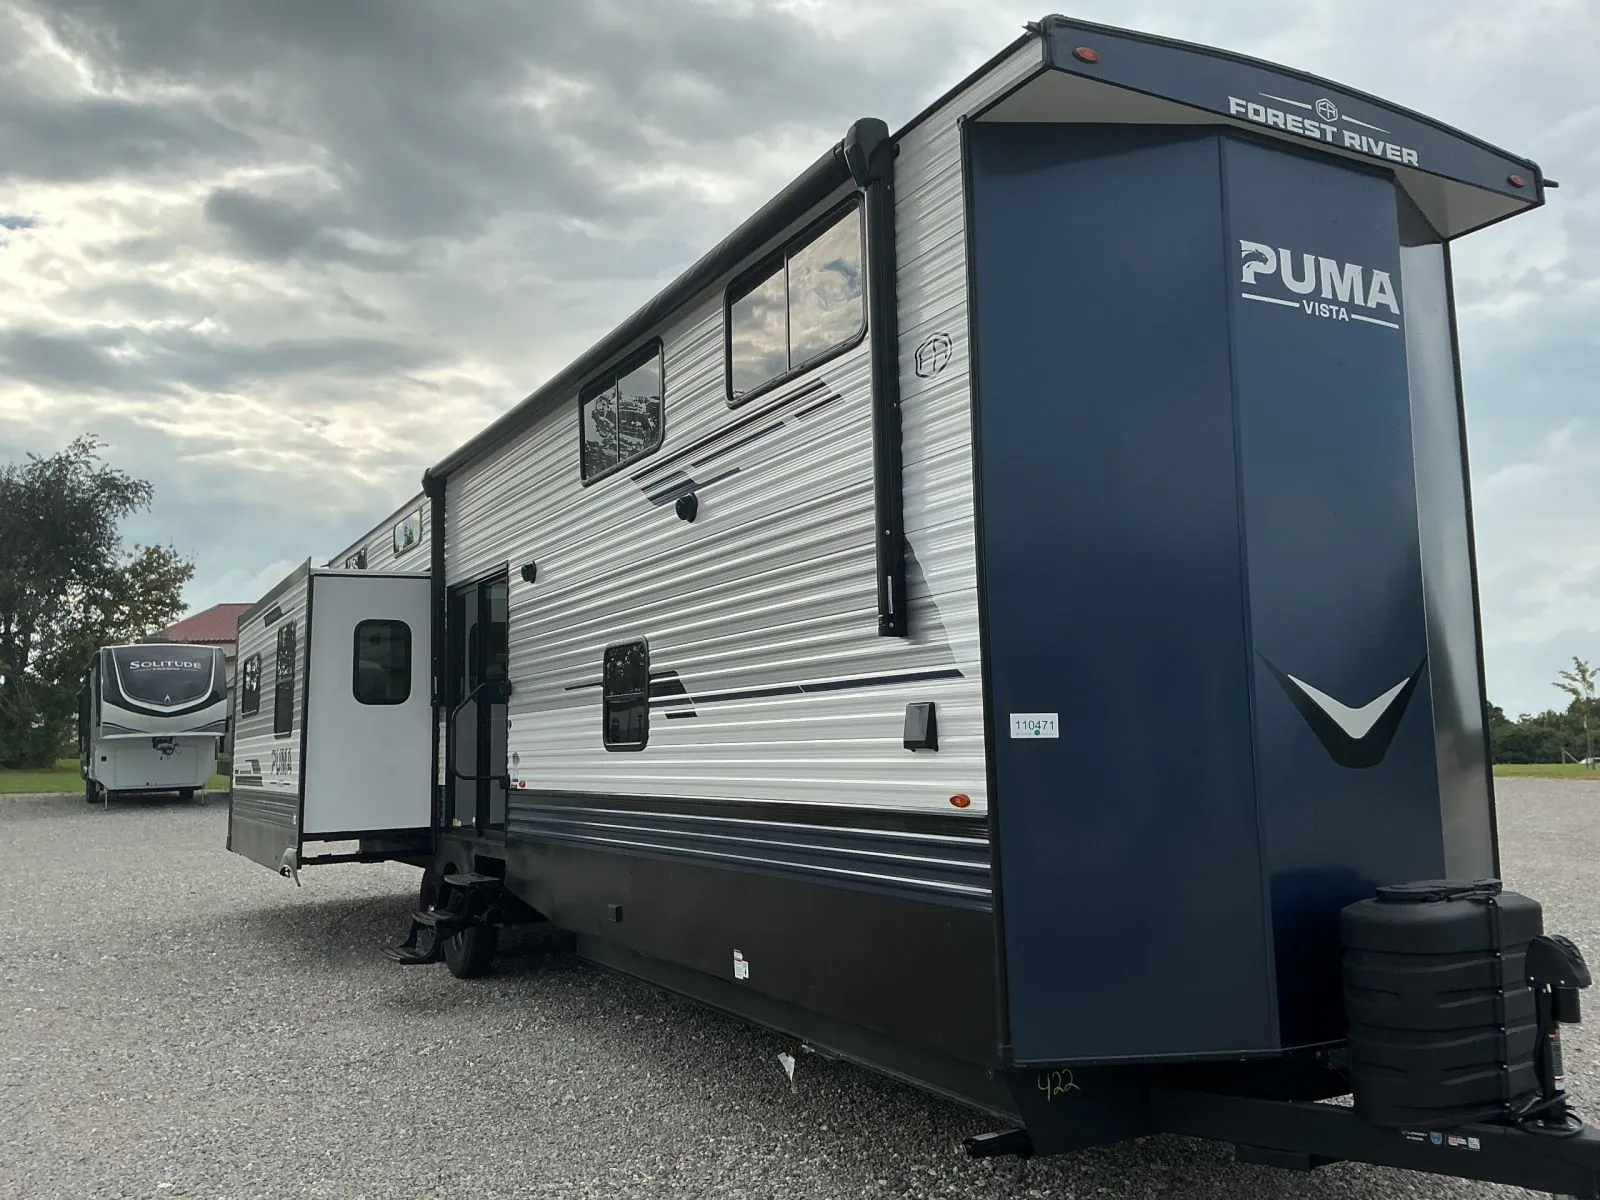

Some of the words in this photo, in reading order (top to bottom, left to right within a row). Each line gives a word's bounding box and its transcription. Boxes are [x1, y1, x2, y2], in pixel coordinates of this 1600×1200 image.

[1228, 96, 1337, 142] FOREST
[1342, 129, 1419, 167] RIVER
[1239, 239, 1400, 314] PUMA
[1303, 299, 1349, 321] VISTA
[129, 660, 202, 670] SOLITUDE
[1015, 720, 1055, 730] 110471
[1037, 1068, 1081, 1102] 422
